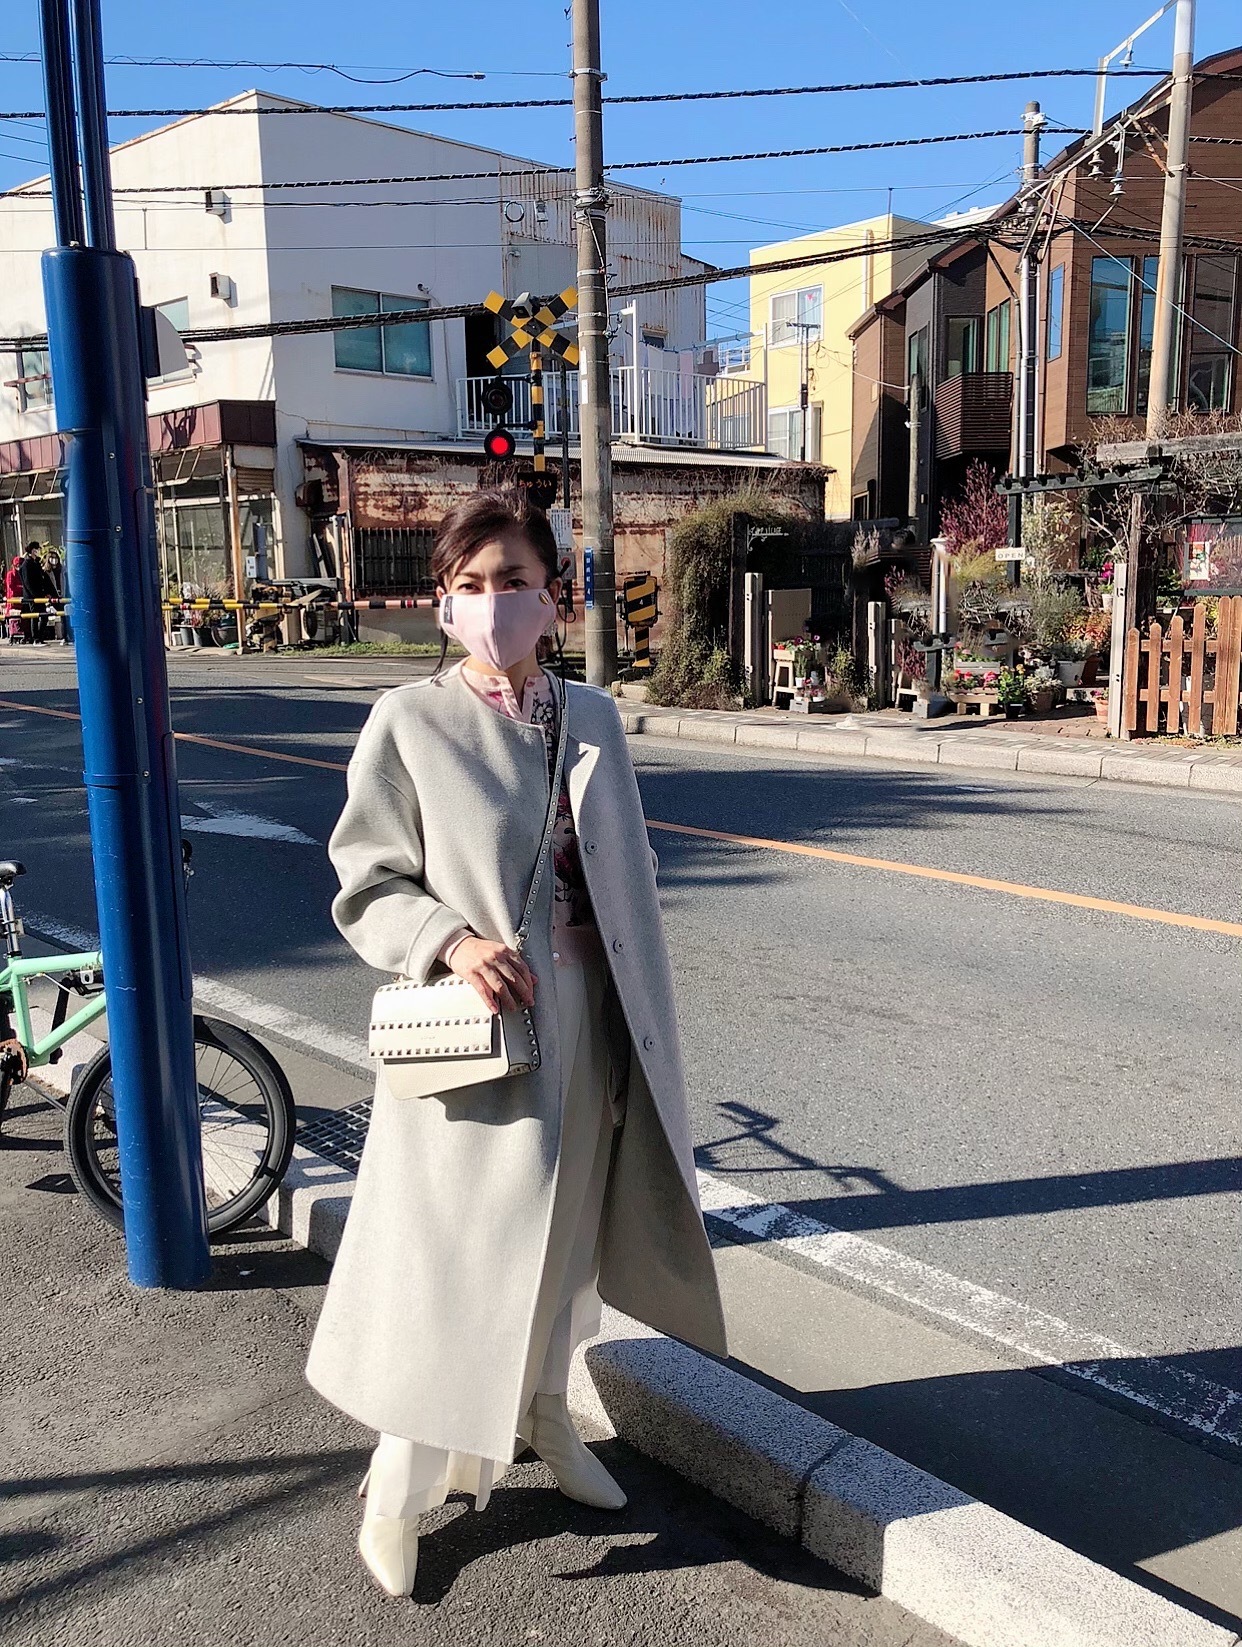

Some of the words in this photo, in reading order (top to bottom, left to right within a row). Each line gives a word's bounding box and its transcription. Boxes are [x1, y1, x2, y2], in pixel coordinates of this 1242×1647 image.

[519, 479, 552, 488] ちゅうい
[997, 552, 1024, 560] OPEN
